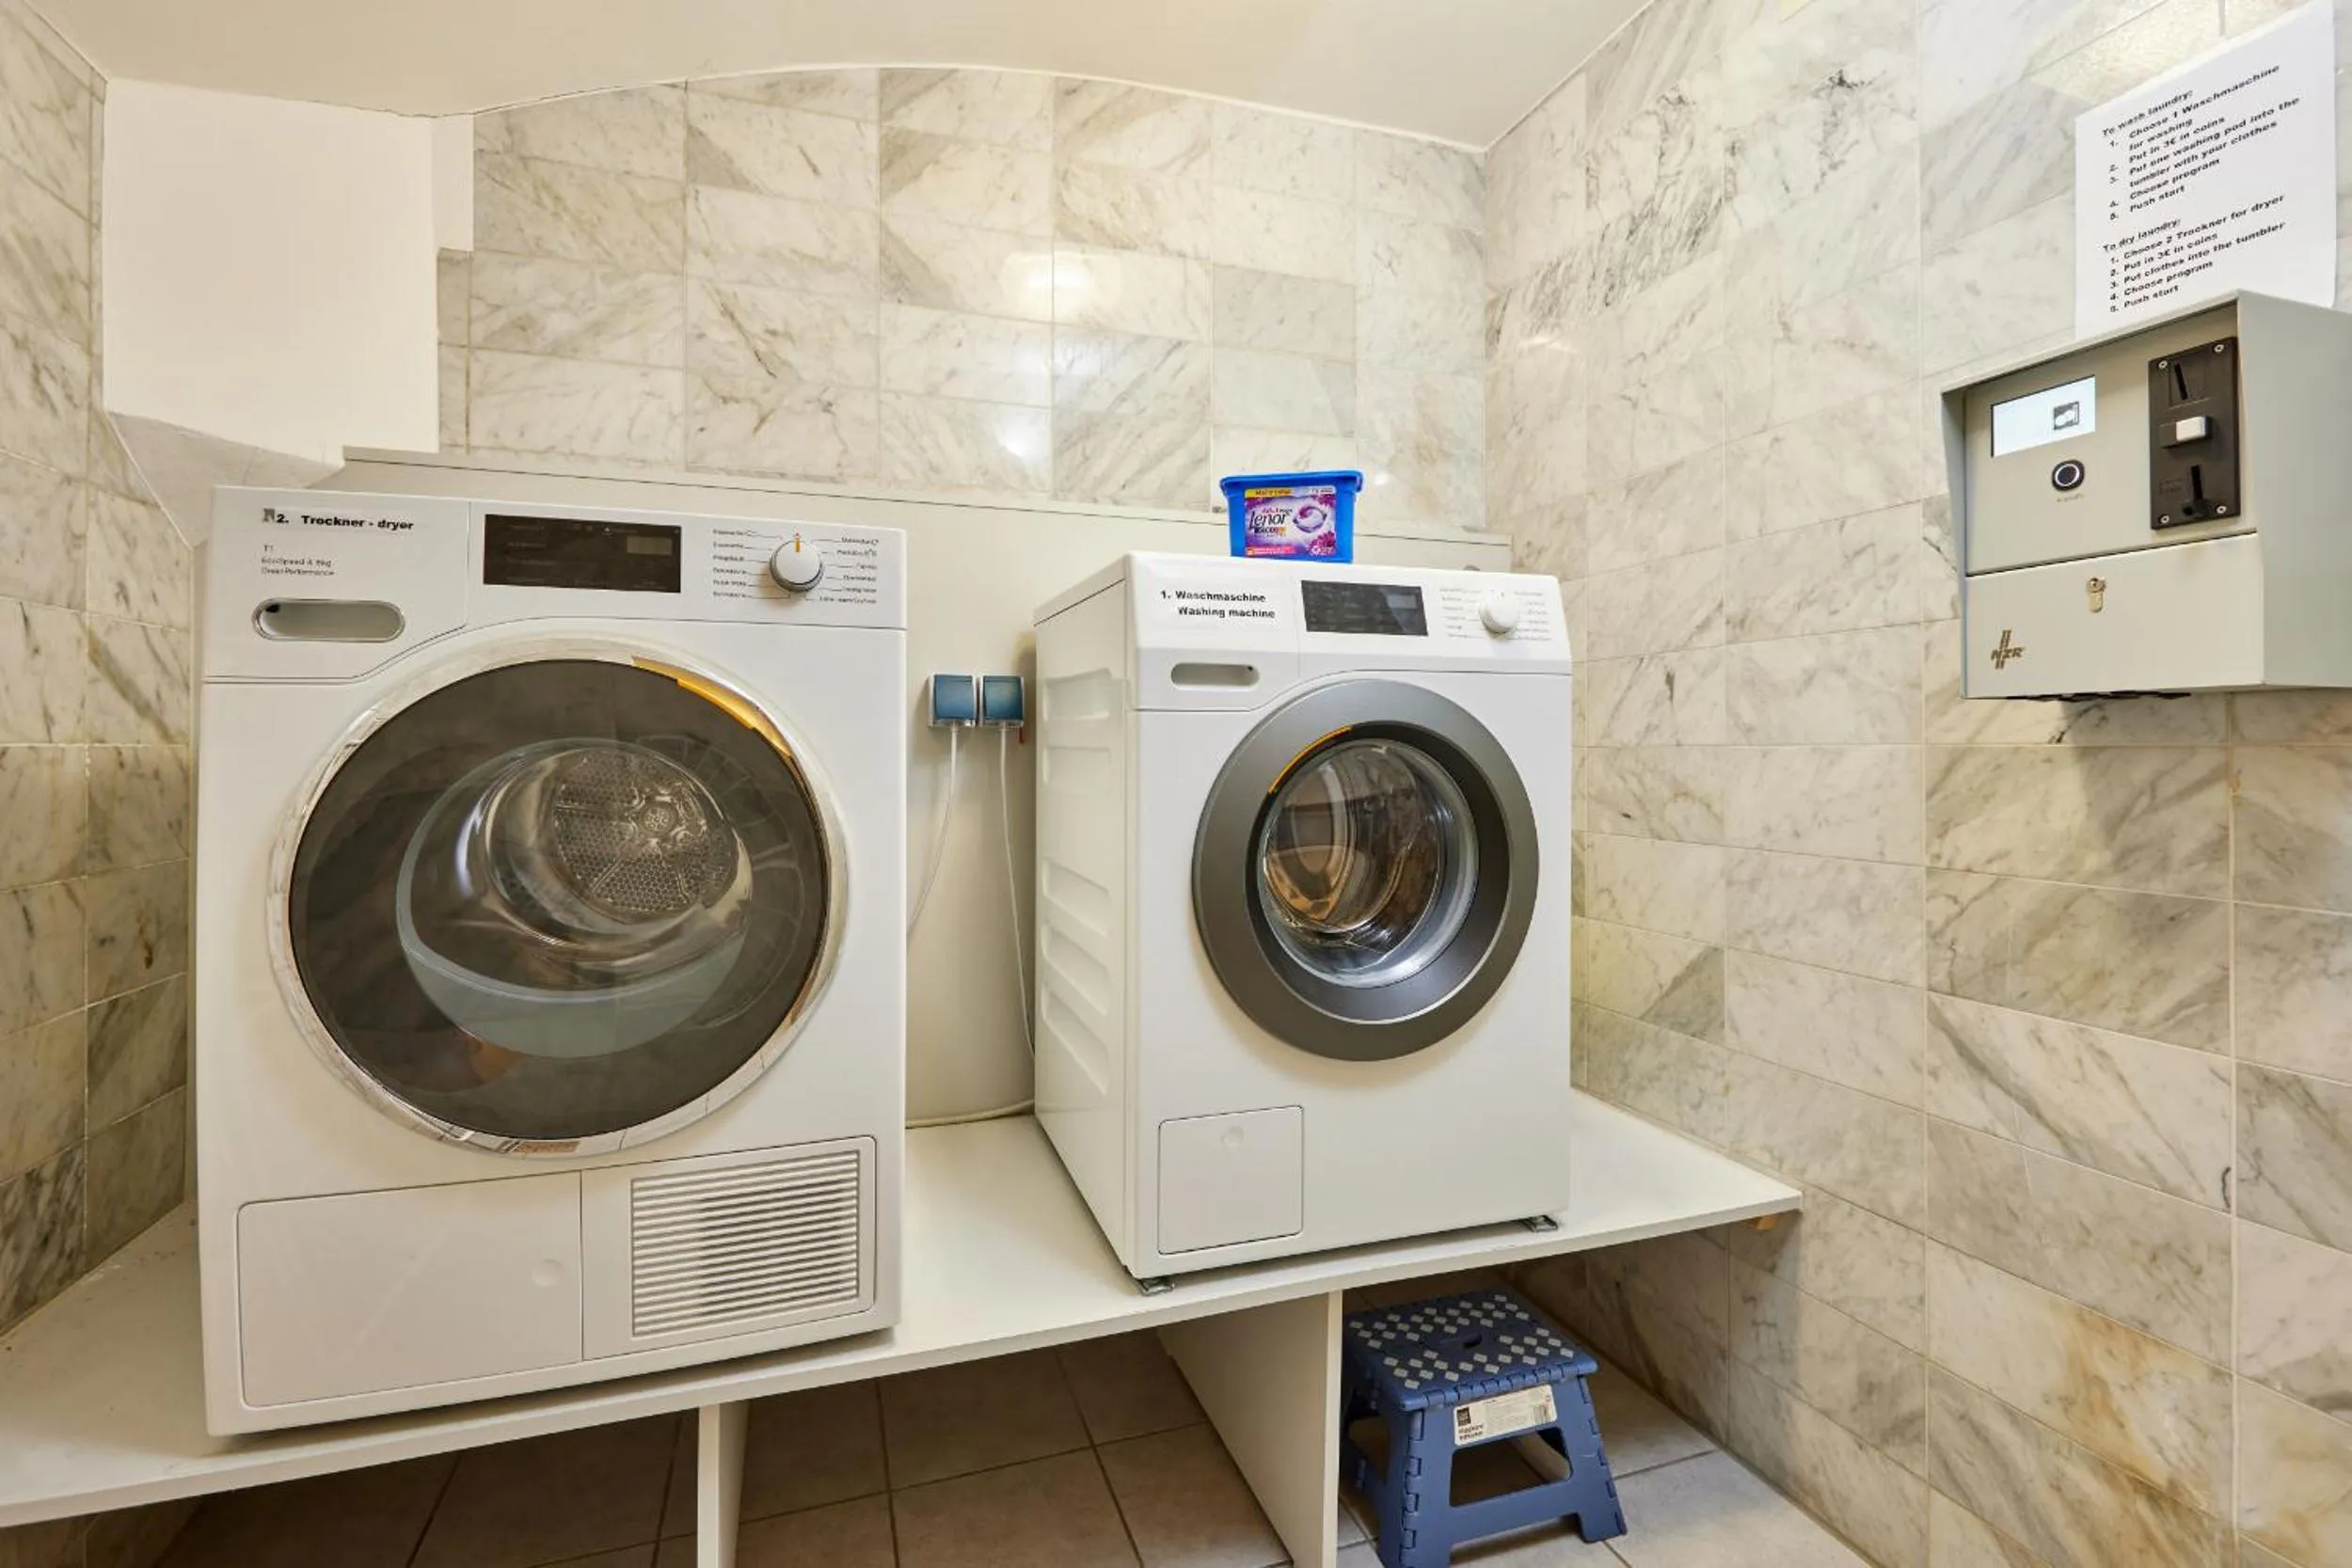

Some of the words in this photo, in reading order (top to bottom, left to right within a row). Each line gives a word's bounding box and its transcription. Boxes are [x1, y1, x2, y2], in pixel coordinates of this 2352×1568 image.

[2102, 128, 2117, 138] To
[2119, 112, 2145, 131] wash
[2148, 90, 2193, 115] laundry:
[2109, 140, 2119, 149] 1.
[2129, 117, 2169, 138] Choose
[2182, 65, 2280, 113] Waschmaschine
[2109, 164, 2118, 172] 2.
[2130, 151, 2147, 163] Put
[2150, 147, 2160, 155] in
[2164, 139, 2176, 149] 3€
[2180, 132, 2189, 140] in
[2193, 116, 2225, 135] coins
[2129, 140, 2143, 150] for
[2147, 119, 2193, 145] washing
[2130, 164, 2146, 176] Put
[2151, 153, 2169, 165] one
[2173, 132, 2221, 157] washing
[2225, 120, 2247, 135] pod
[2250, 108, 2274, 126] into
[2279, 97, 2299, 111] the
[2130, 166, 2170, 188] tumbler
[2174, 153, 2199, 168] with
[2201, 142, 2228, 161] your
[2231, 121, 2278, 146] clothes
[2130, 180, 2169, 200] Choose
[2171, 158, 2220, 184] program
[2130, 197, 2155, 212] Push
[2159, 185, 2185, 204] start
[2103, 244, 2117, 252] To
[2120, 235, 2136, 248] dry
[2124, 240, 2163, 260] Choose
[2231, 209, 2248, 221] for
[2250, 195, 2284, 214] dryer
[2124, 260, 2141, 271] Put
[2144, 256, 2153, 264] in
[2158, 250, 2171, 260] 3€
[2188, 233, 2217, 248] coins
[2124, 272, 2141, 283] Put
[2145, 258, 2185, 278] clothes
[2188, 249, 2210, 263] into
[2214, 239, 2233, 252] the
[2236, 223, 2286, 245] tumbler
[2124, 278, 2164, 295] Choose
[2167, 261, 2214, 284] program
[2124, 294, 2150, 308] Push
[2153, 285, 2179, 299] start
[277, 514, 289, 524] 2.
[301, 515, 365, 528] Trockner
[377, 520, 413, 530] dryer
[1176, 591, 1265, 602] Waschmaschine
[1178, 607, 1225, 618] Washing
[1229, 610, 1275, 618] machine
